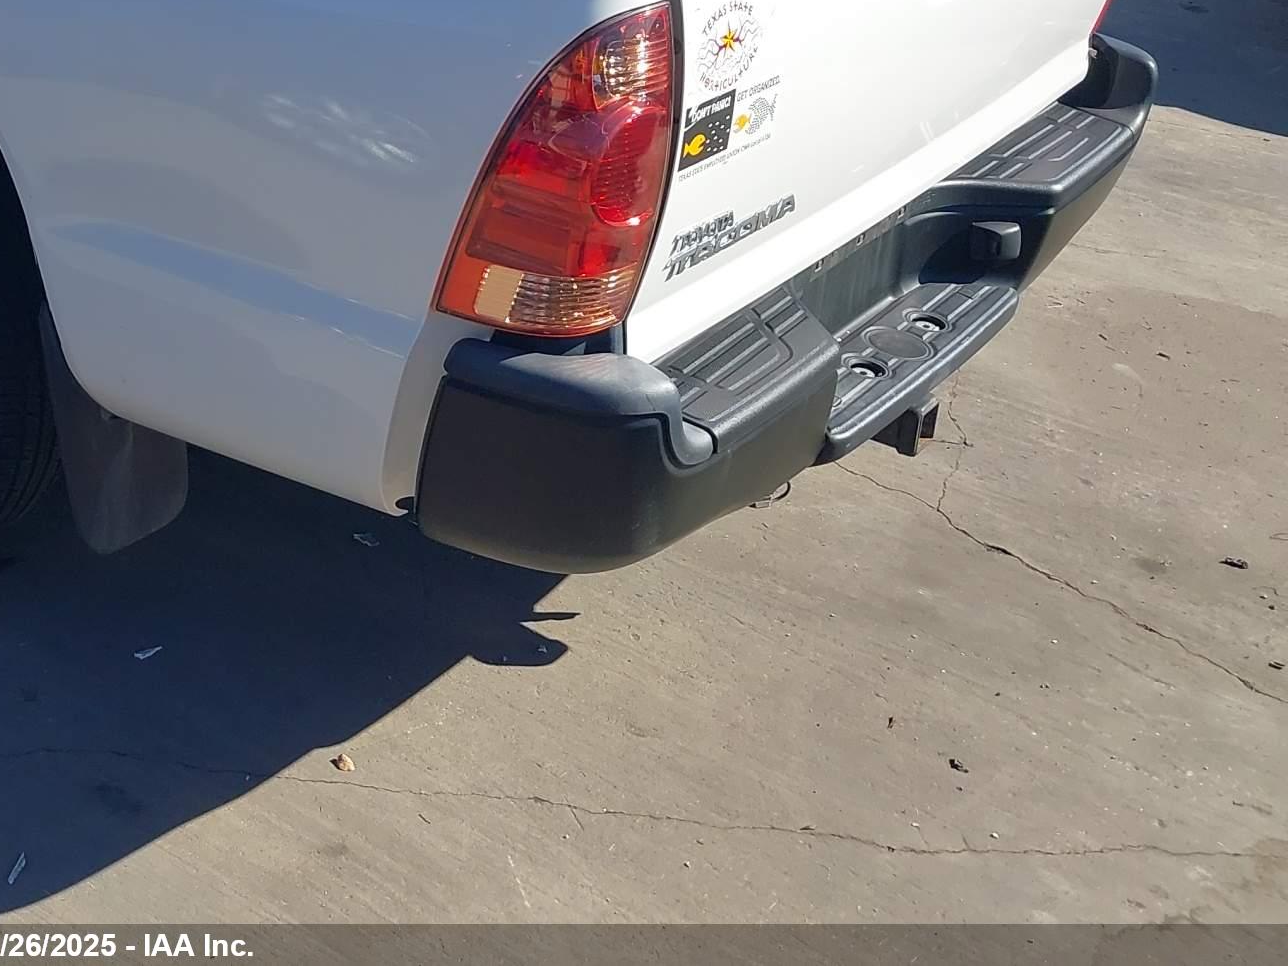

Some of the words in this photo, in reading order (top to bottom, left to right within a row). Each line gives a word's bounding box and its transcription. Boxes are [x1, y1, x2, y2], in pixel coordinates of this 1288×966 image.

[702, 4, 727, 36] TEXAS
[729, 0, 753, 16] STATE
[737, 90, 748, 102] GET
[662, 194, 795, 282] TACOMA
[670, 210, 734, 257] TOYOTA
